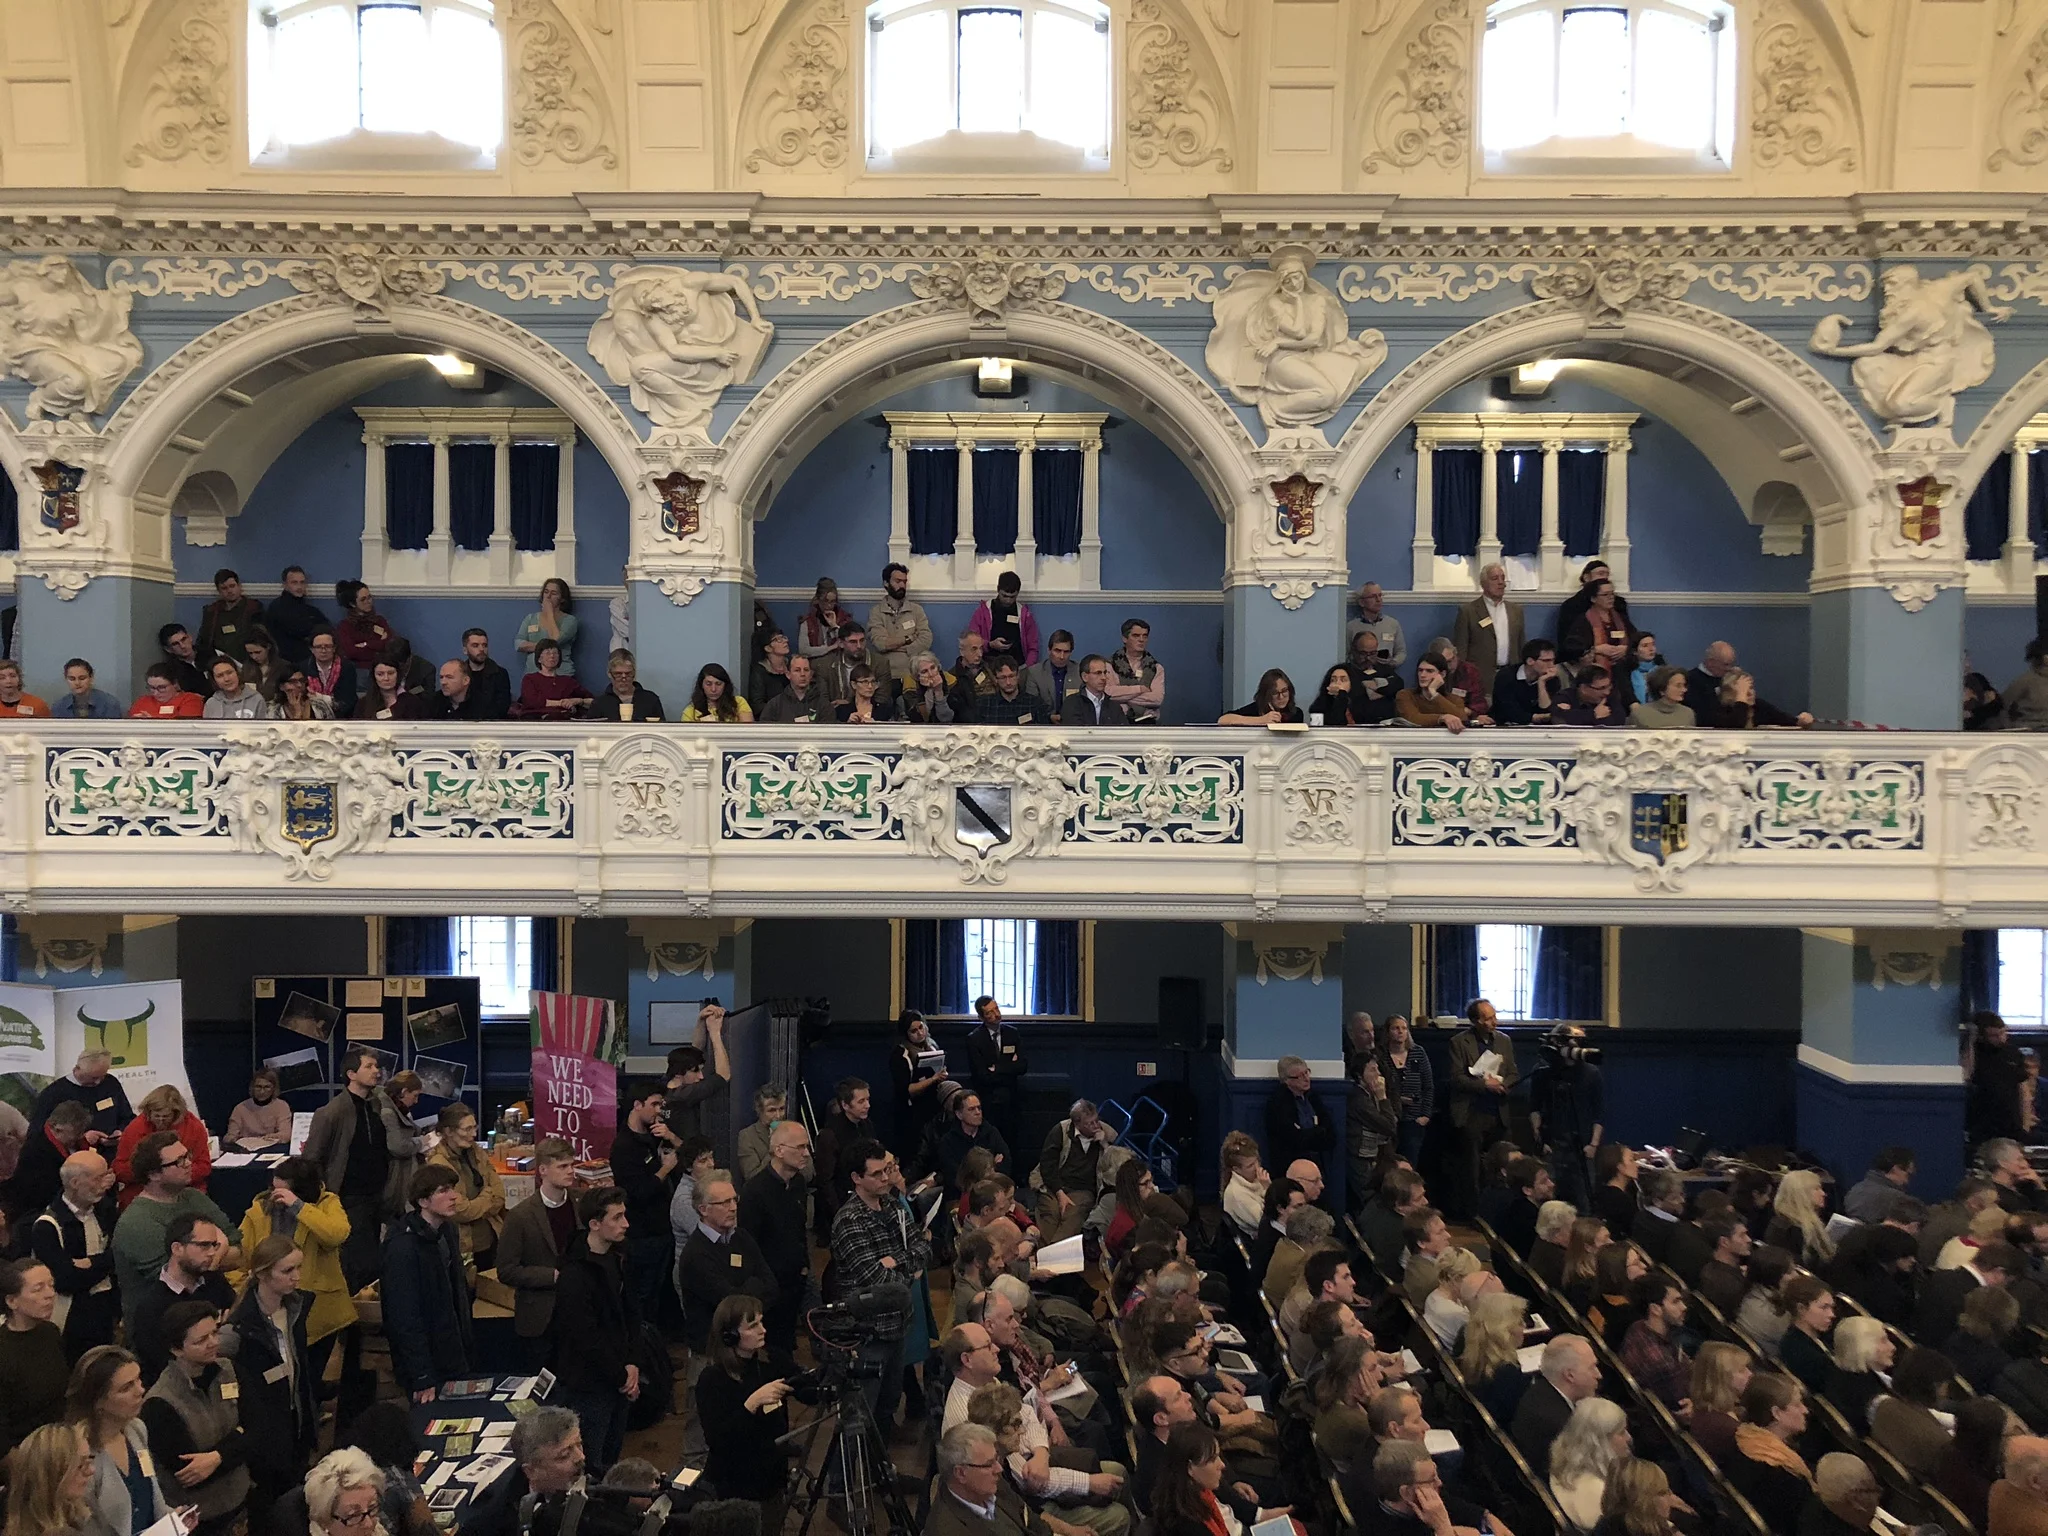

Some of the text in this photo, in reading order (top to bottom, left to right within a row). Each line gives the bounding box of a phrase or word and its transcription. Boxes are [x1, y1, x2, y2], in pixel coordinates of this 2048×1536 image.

[118, 1069, 157, 1080] HEALTH
[549, 1054, 583, 1083] WE
[547, 1080, 593, 1110] NEED
[553, 1106, 580, 1134] TO
